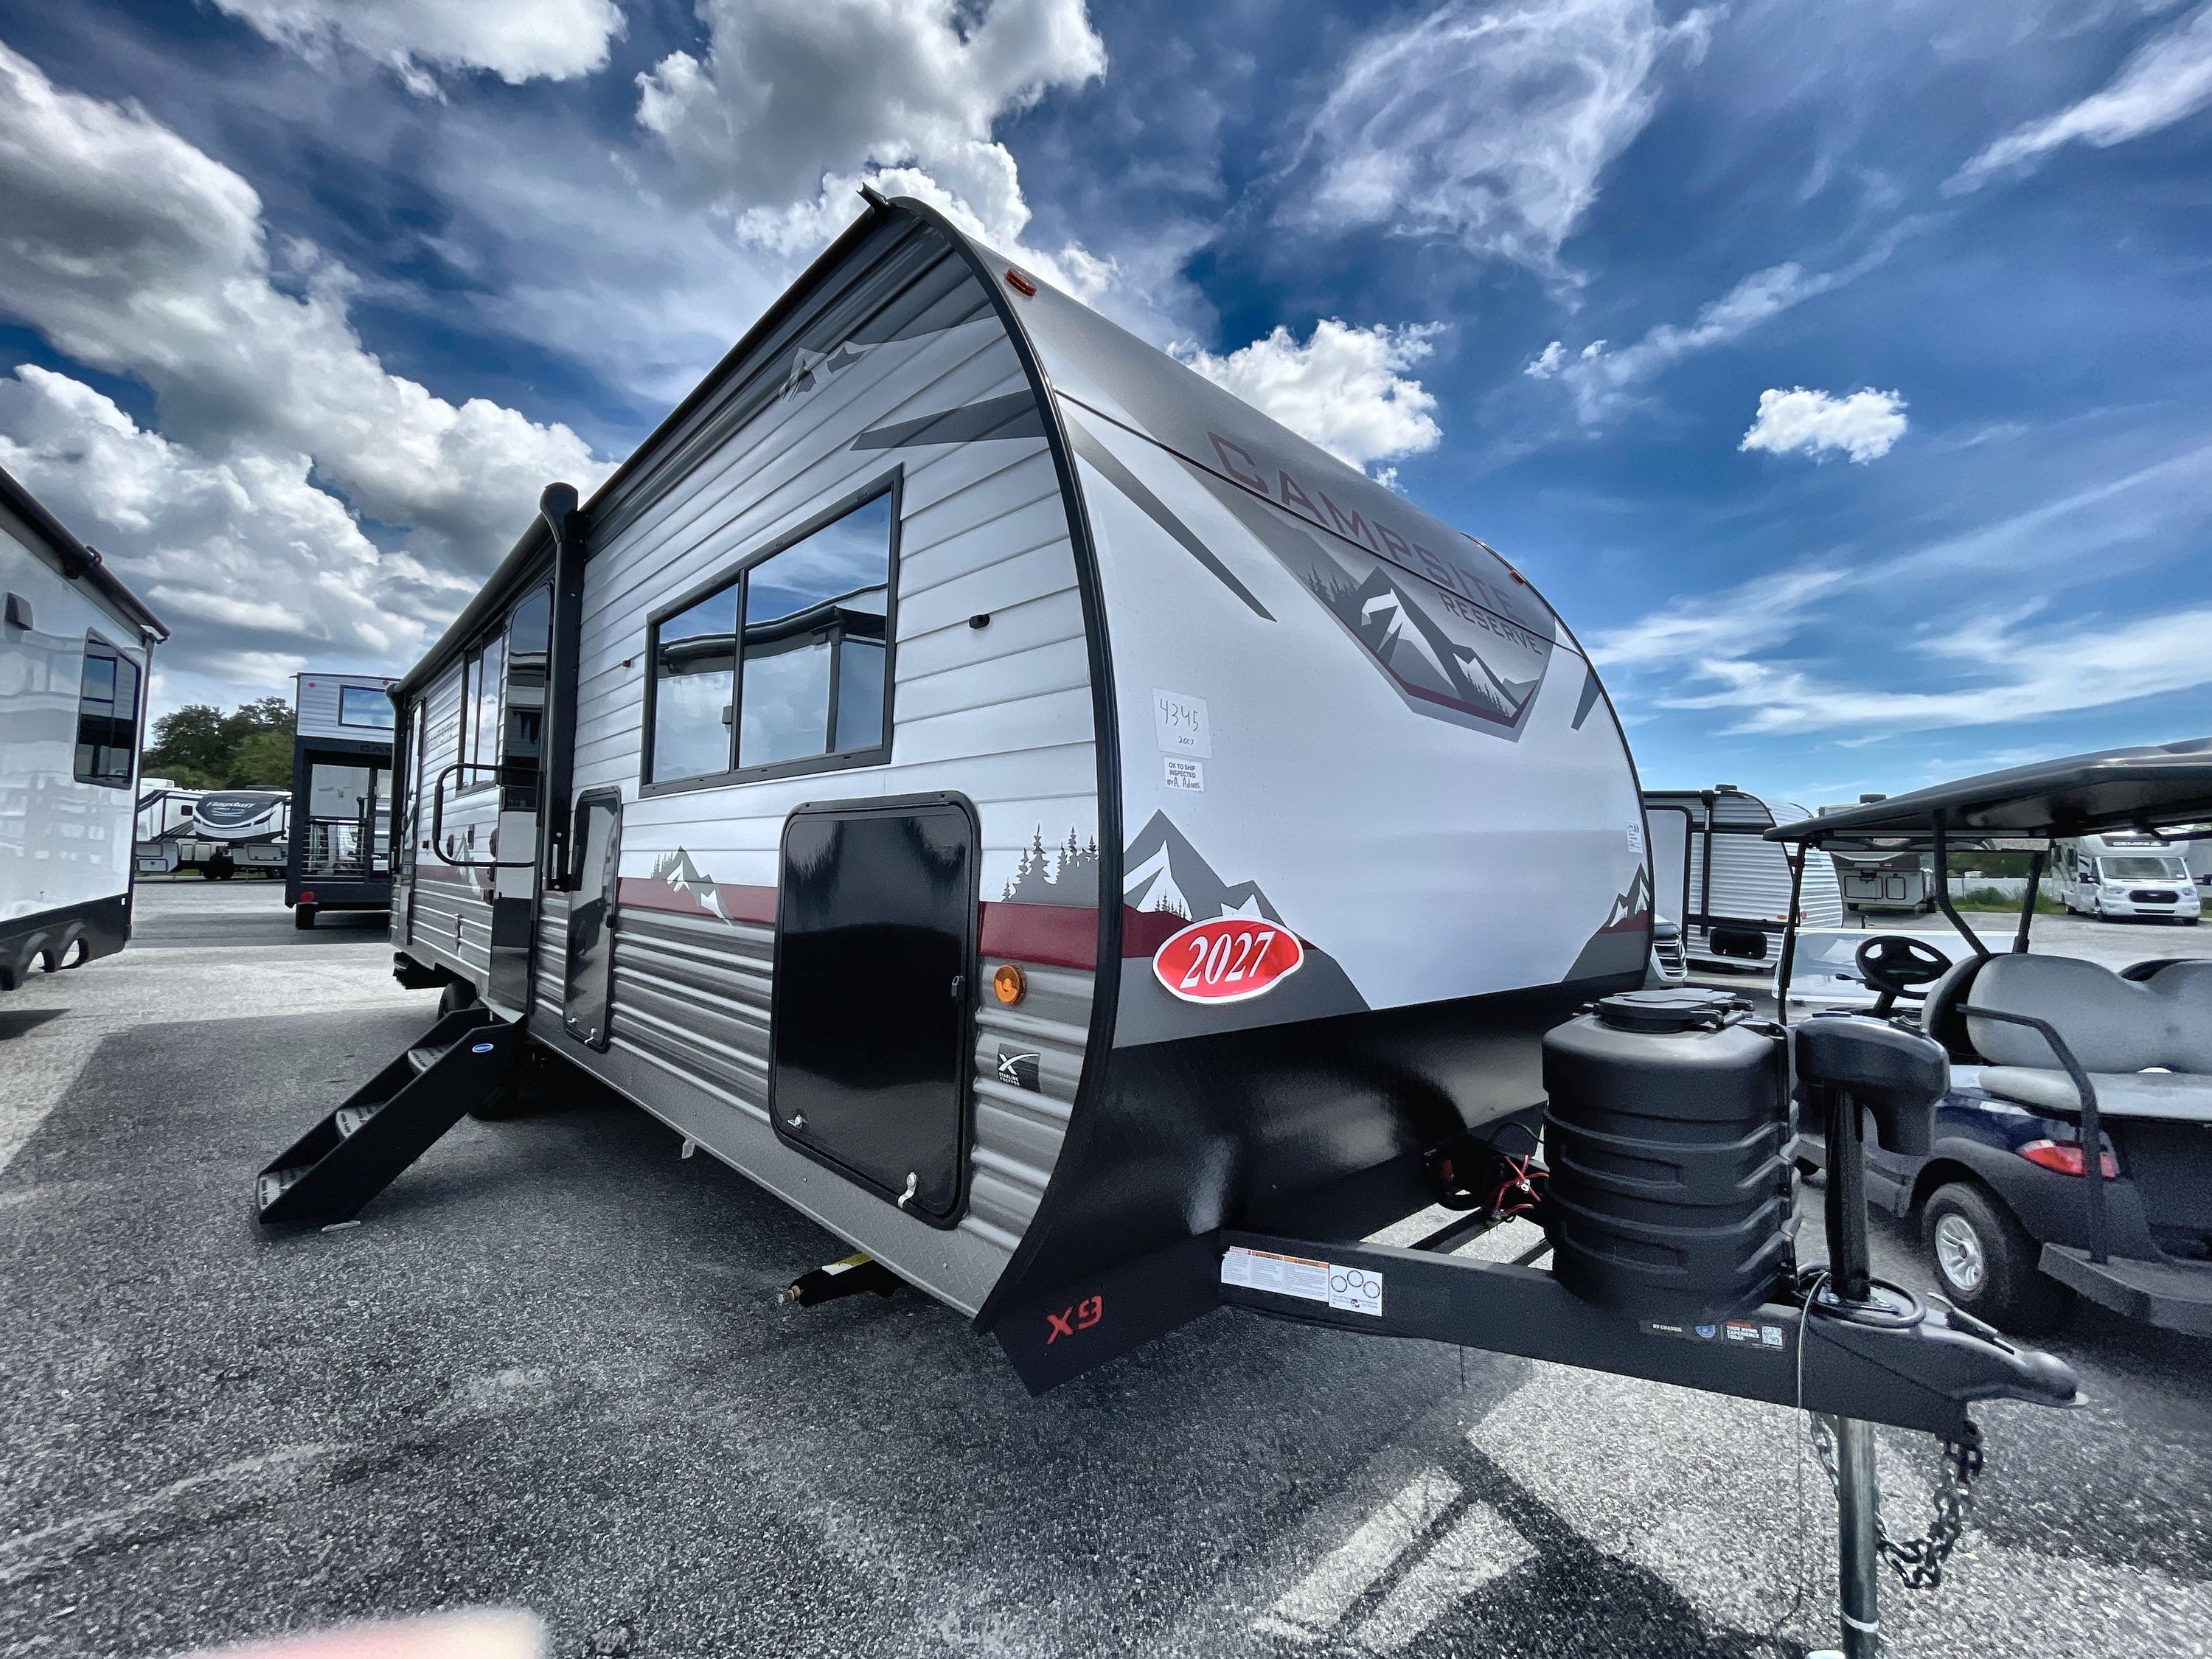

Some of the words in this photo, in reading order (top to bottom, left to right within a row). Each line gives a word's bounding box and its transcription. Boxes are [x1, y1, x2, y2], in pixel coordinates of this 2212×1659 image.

[1207, 431, 1527, 625] CAMPSITE
[1436, 591, 1543, 655] RESERVE
[1160, 698, 1199, 731] 4345
[1169, 770, 1196, 778] INSPECTED
[1179, 931, 1276, 990] 2027
[1046, 1295, 1102, 1345] X9
